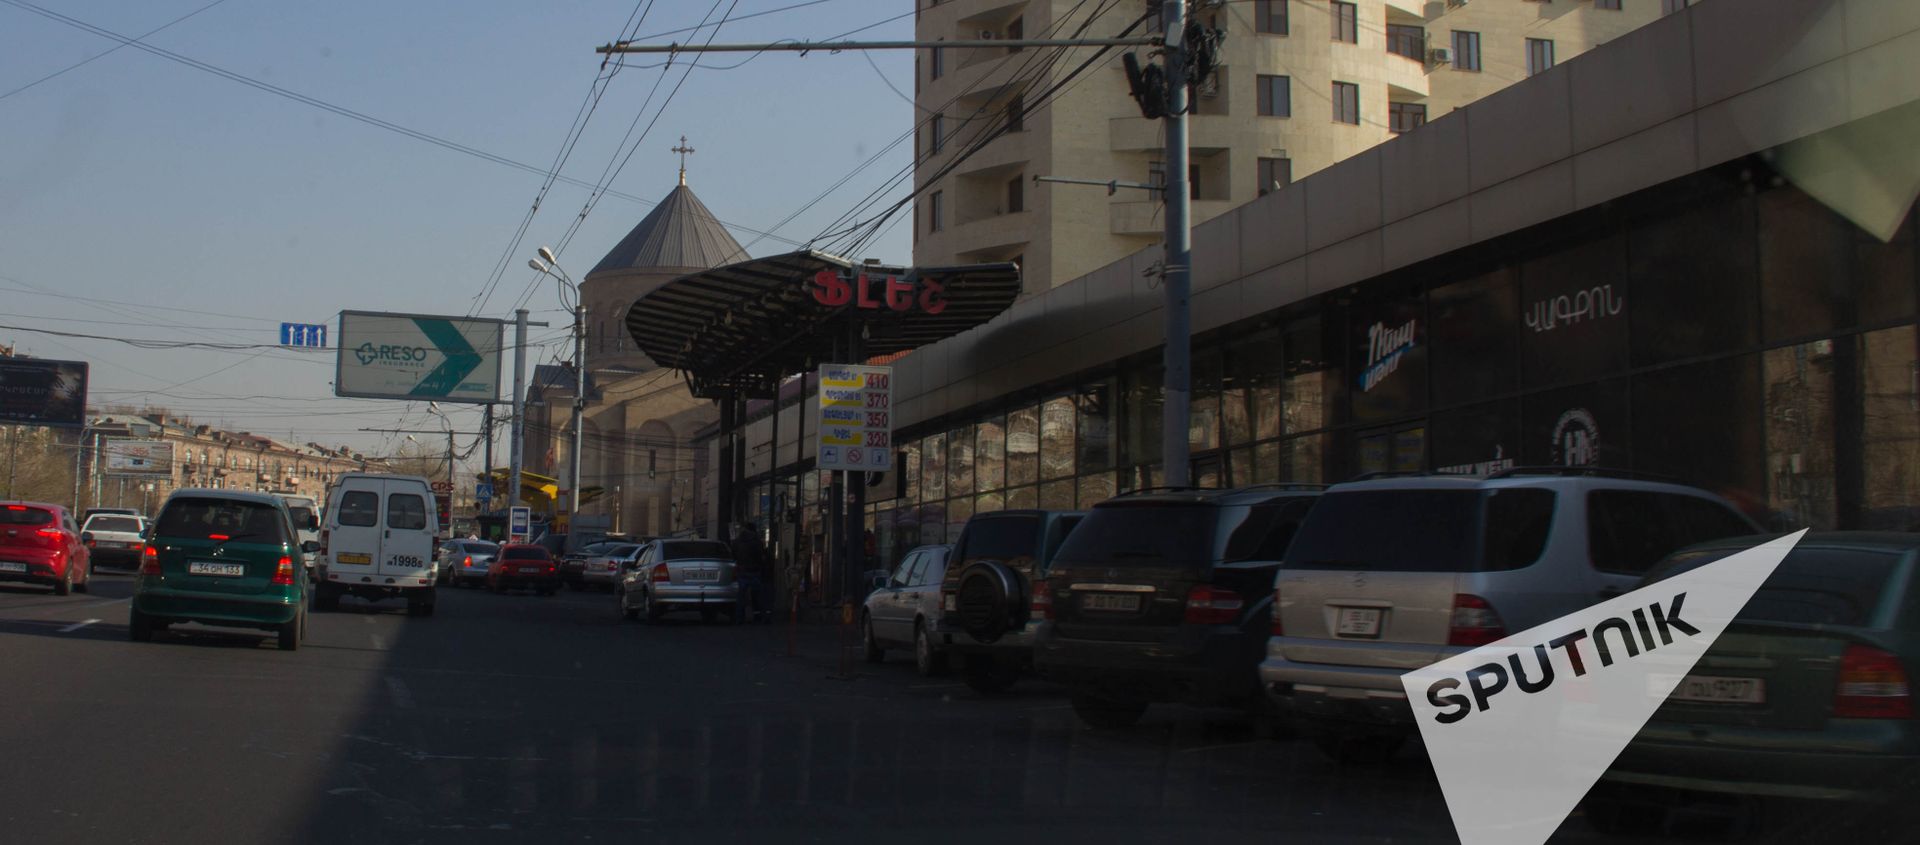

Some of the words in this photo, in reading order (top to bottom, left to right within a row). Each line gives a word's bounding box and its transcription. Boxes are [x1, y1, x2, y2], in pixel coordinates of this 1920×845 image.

[812, 270, 949, 315] ՖԼԵՇ
[380, 344, 427, 362] RESO
[866, 373, 889, 389] 410
[866, 392, 889, 408] 370
[866, 411, 888, 428] 350
[866, 431, 888, 448] 320
[199, 563, 209, 573] 34
[225, 565, 240, 575] 133
